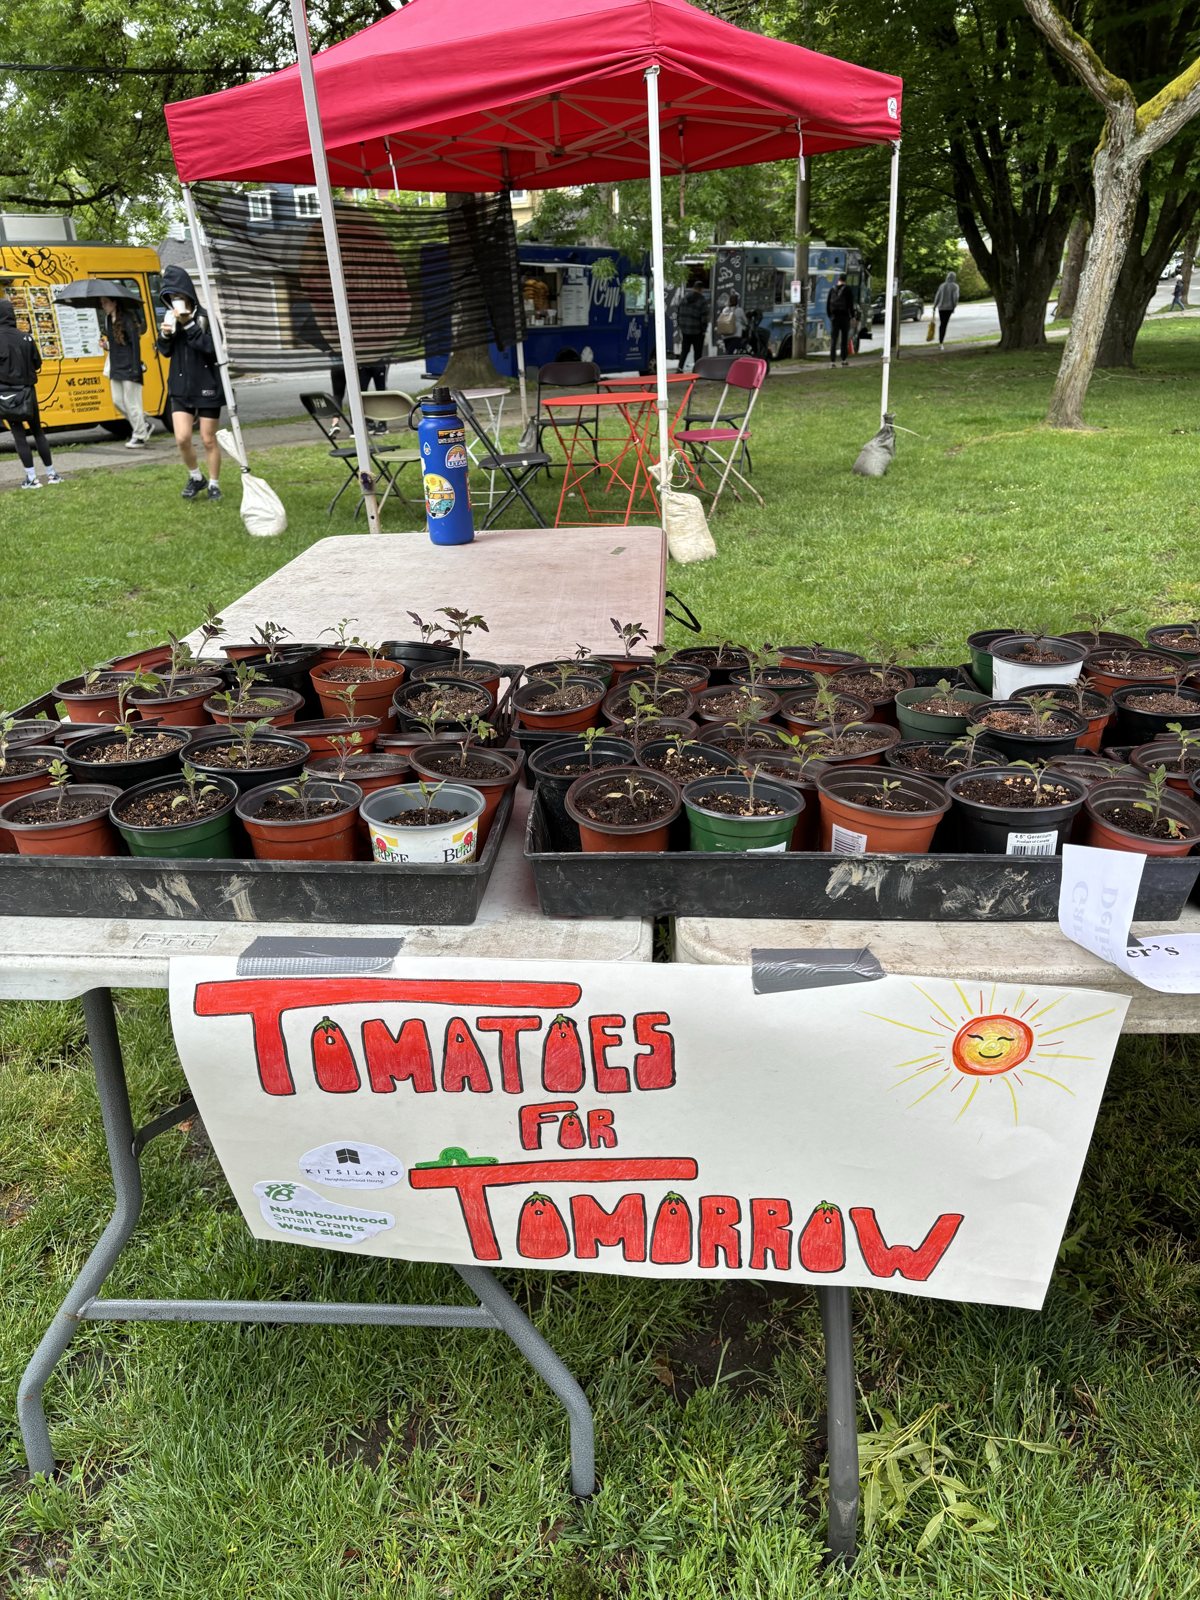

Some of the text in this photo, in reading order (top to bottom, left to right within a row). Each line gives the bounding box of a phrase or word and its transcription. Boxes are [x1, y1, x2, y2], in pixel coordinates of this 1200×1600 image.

[194, 979, 677, 1097] TOMATOES
[518, 1101, 618, 1151] FOR
[305, 1168, 399, 1176] KITSILANO
[269, 1205, 388, 1225] Neighbourhood
[273, 1213, 365, 1232] Small Grants
[408, 1157, 965, 1282] TOMORROW
[277, 1222, 353, 1239] West Side
